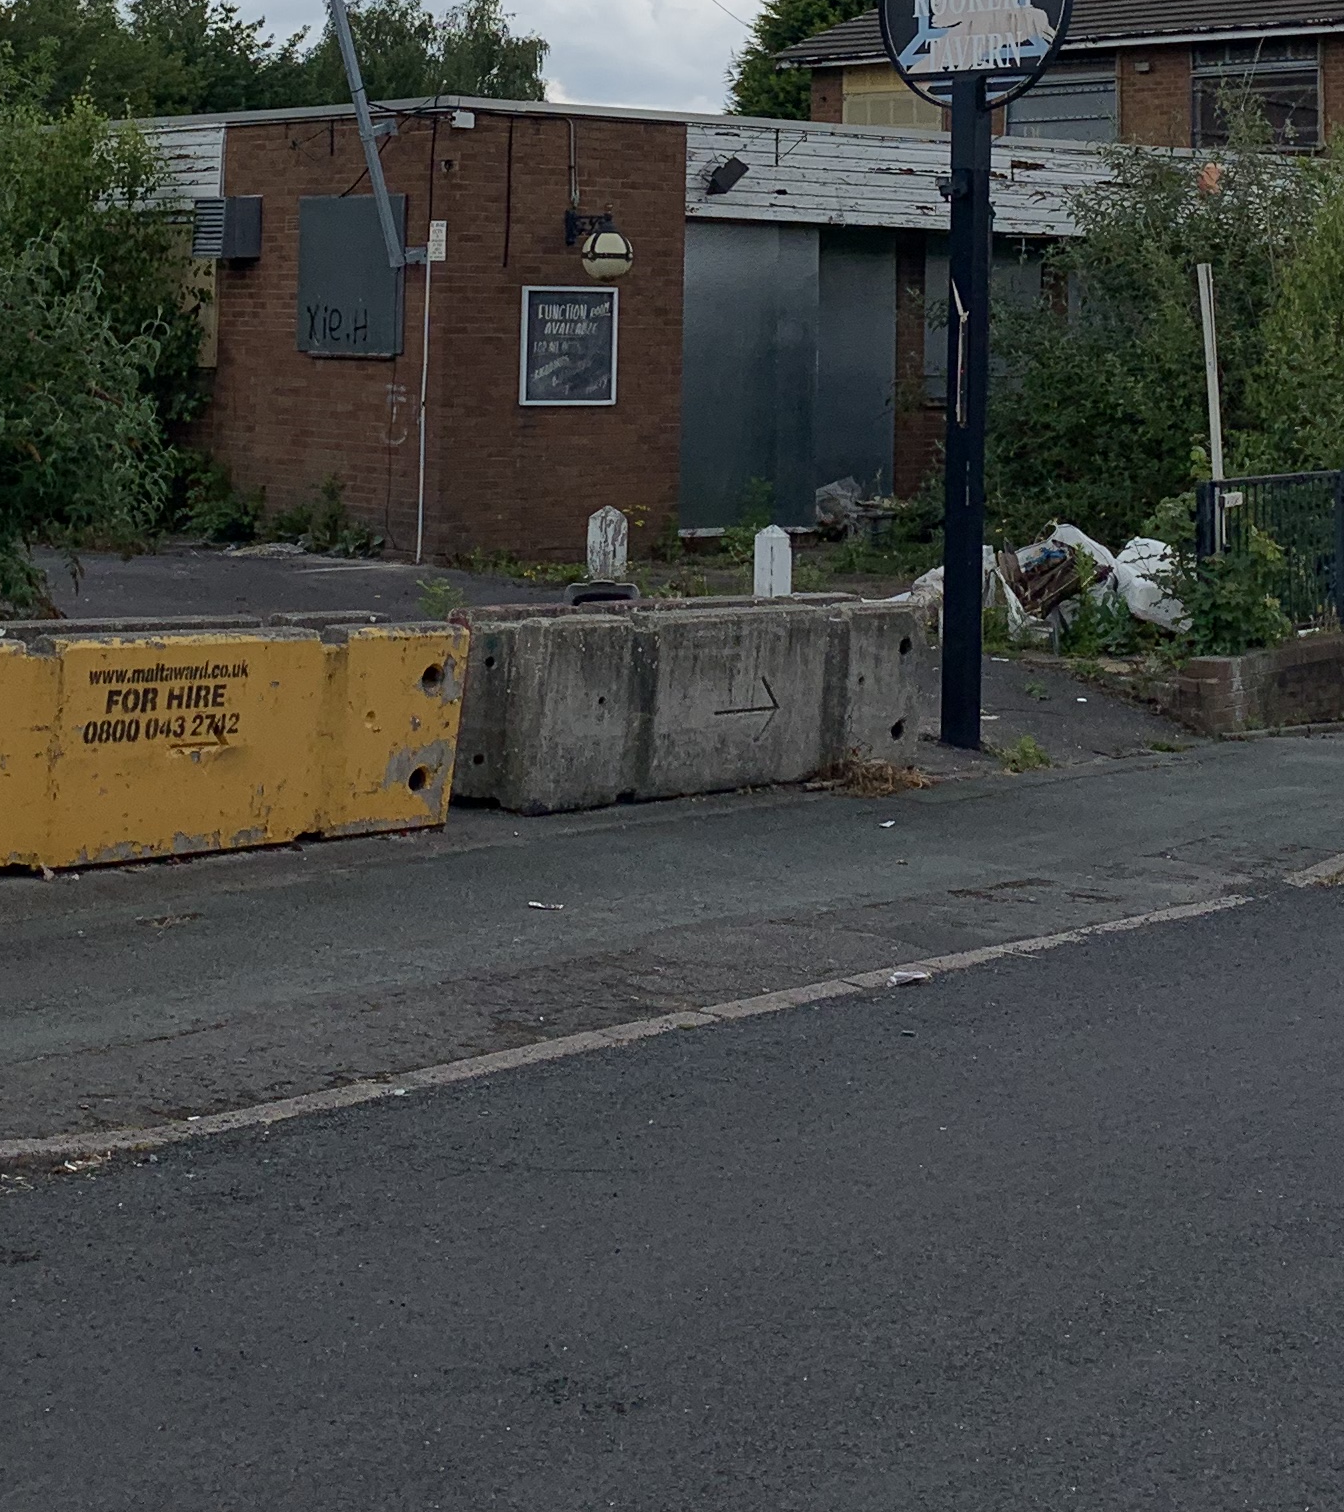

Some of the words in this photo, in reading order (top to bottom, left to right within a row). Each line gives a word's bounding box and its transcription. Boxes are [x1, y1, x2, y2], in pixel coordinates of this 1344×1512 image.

[925, 31, 1022, 72] TAVERN
[538, 303, 587, 320] FUNCTION
[89, 659, 249, 686] www.maltaward.co.uk
[106, 688, 158, 714] FOR
[166, 684, 227, 710] HIRE
[83, 719, 140, 744] 0800
[145, 715, 186, 740] 043
